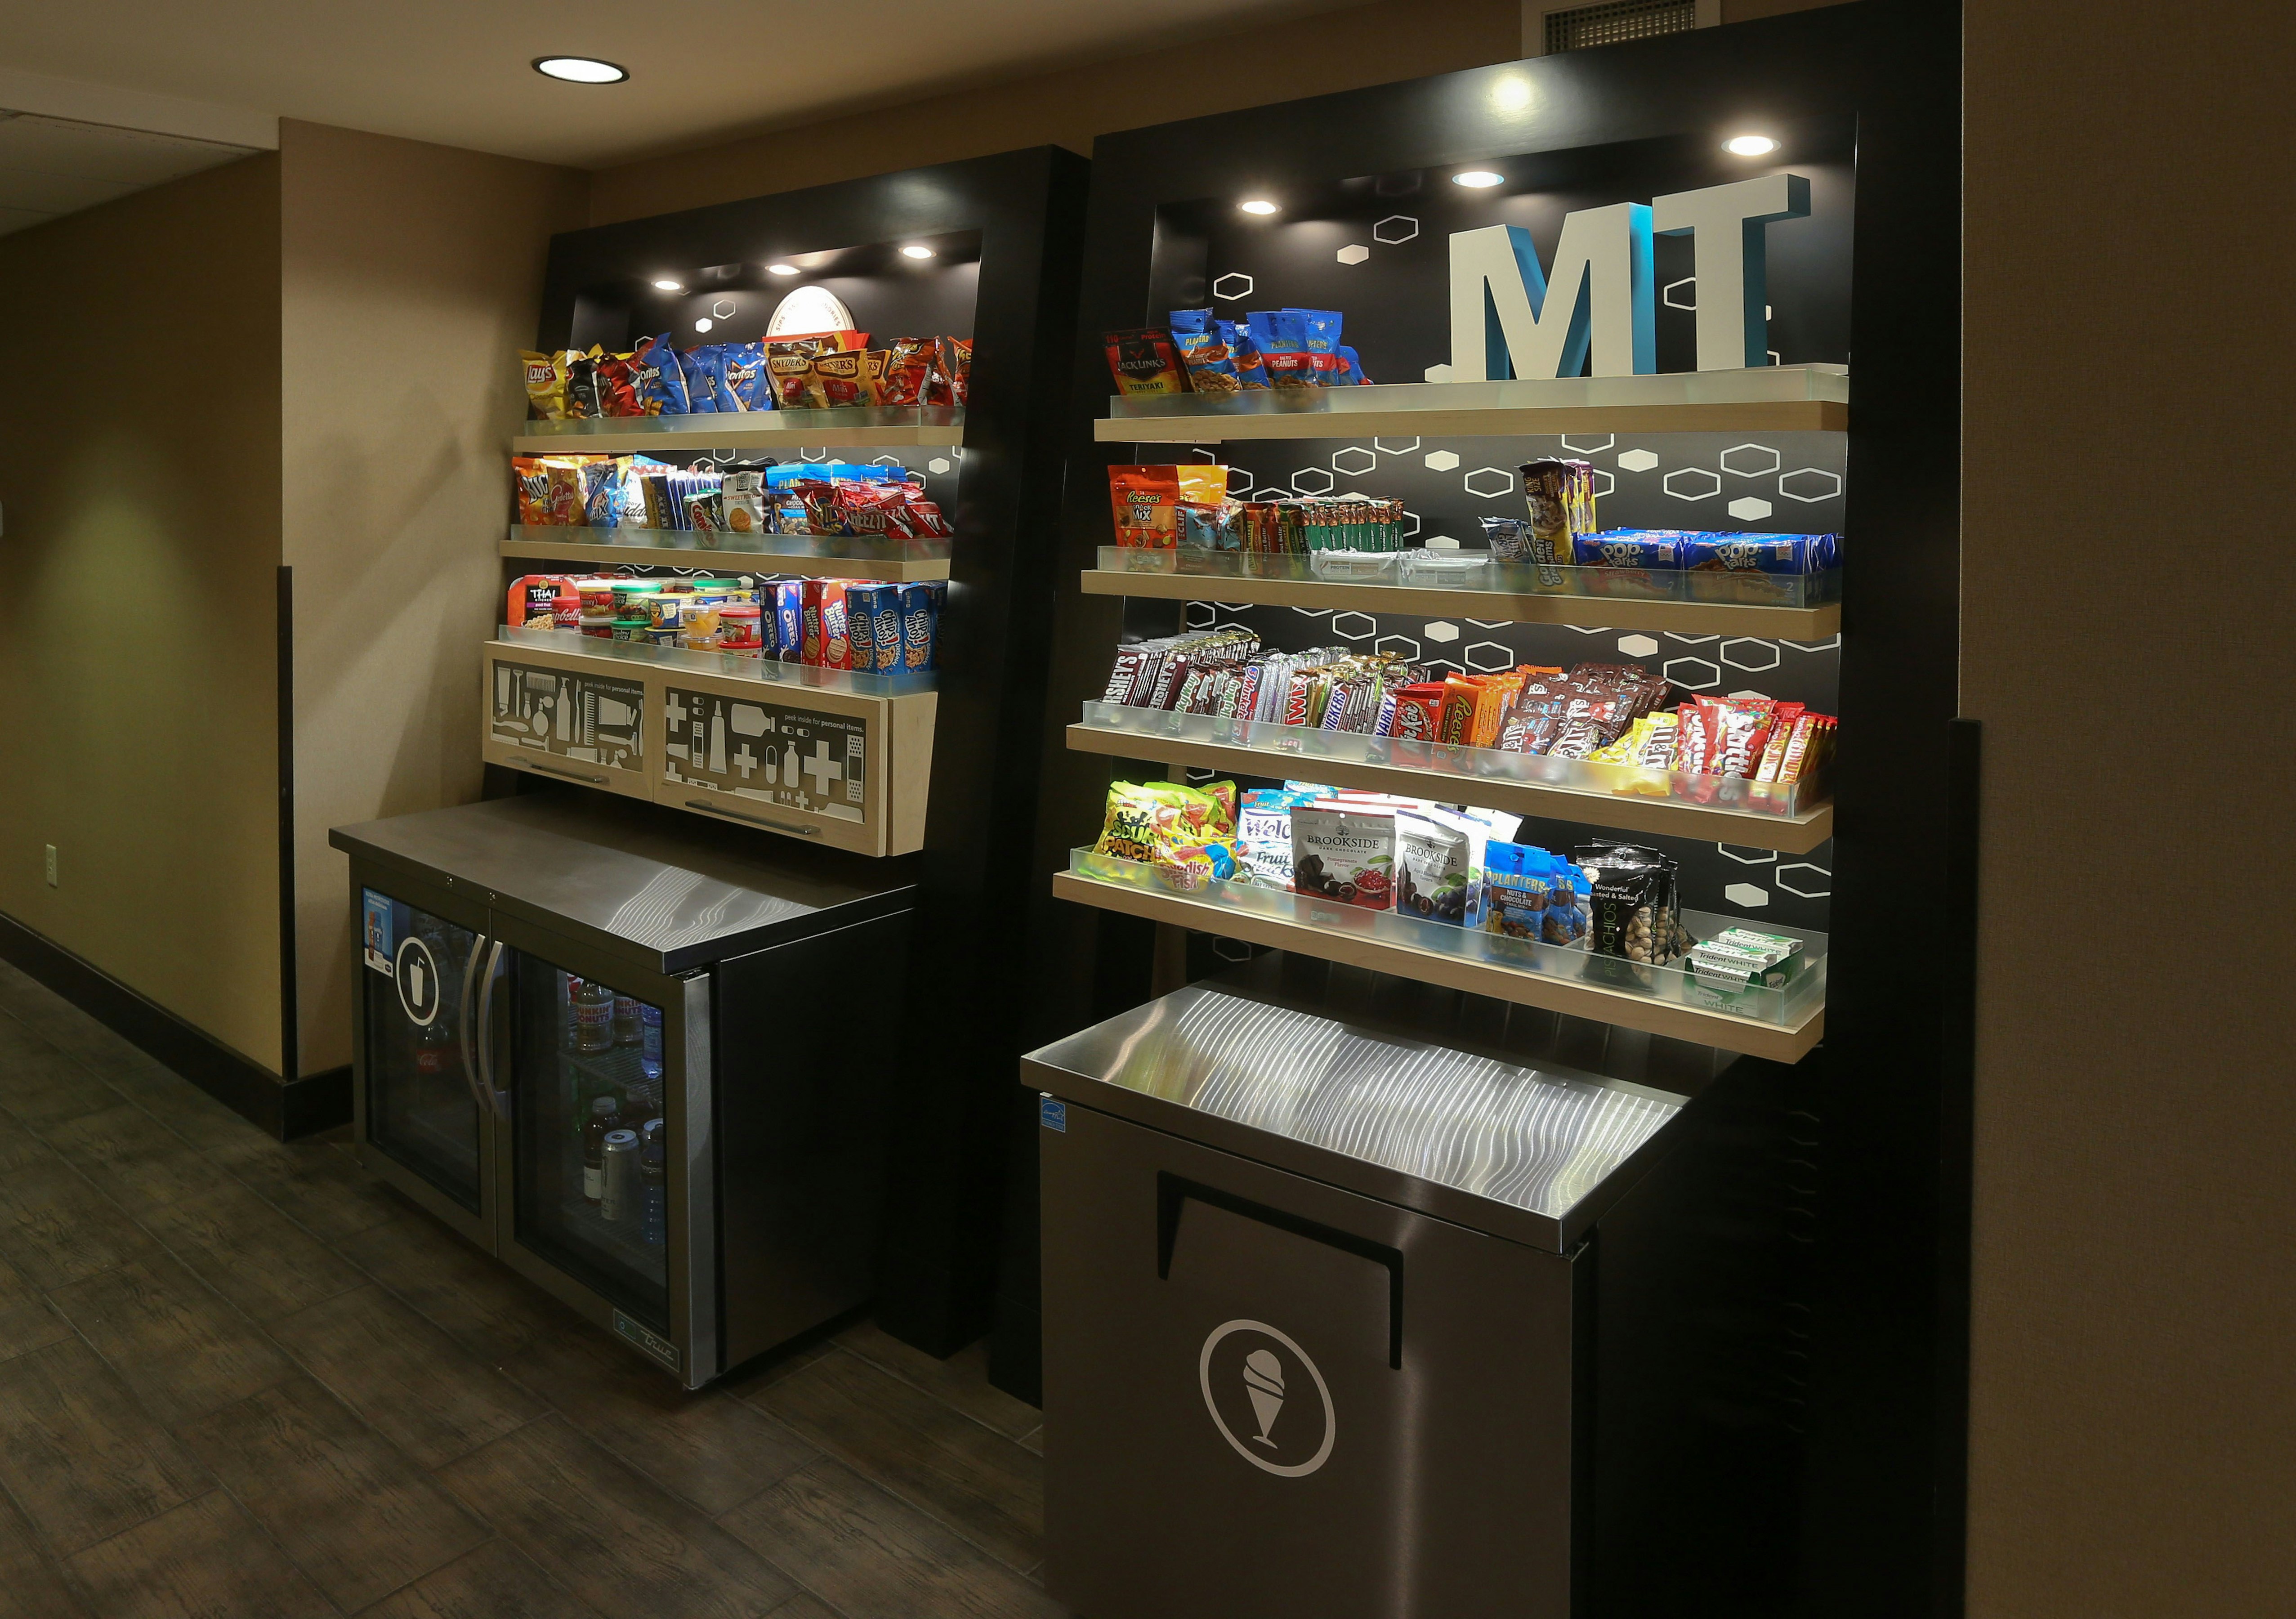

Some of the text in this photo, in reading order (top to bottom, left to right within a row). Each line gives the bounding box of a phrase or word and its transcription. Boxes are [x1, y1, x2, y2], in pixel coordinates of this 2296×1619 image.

[1449, 174, 1811, 381] MT
[1272, 359, 1298, 368] PEANUTS
[1129, 382, 1164, 391] TERIYAKI
[1524, 476, 1534, 493] KING
[1532, 477, 1541, 492] SIZE
[1126, 490, 1161, 503] Reese's
[530, 589, 556, 599] THAI
[803, 609, 815, 638] Butter
[809, 605, 820, 635] Nutter
[824, 606, 840, 639] Butter
[832, 600, 847, 635] Nutter
[855, 613, 869, 641] Chips
[880, 610, 896, 637] Chips
[914, 609, 928, 637] Chips
[764, 610, 775, 648] OREO
[783, 609, 796, 646] OREO
[1102, 655, 1138, 704] RSHEY'S
[1148, 661, 1176, 710] ERSHEY'S
[612, 686, 630, 694] personal
[1323, 689, 1346, 731] NICKERS
[1401, 703, 1423, 733] Kat
[784, 714, 797, 723] peek
[798, 716, 812, 725] inside
[821, 720, 845, 732] personal
[846, 723, 865, 733] items.
[1112, 820, 1158, 846] SOUR
[1245, 816, 1291, 839] Welc
[1103, 836, 1156, 863] PATCH
[1307, 835, 1380, 850] BROOKSIDE
[1406, 843, 1458, 867] BROOKSIDE
[1492, 873, 1546, 892] PLANTERS
[1595, 883, 1628, 893] Wonderful
[1500, 894, 1532, 907] CHOCOLATE
[1506, 889, 1522, 898] NUTS
[1618, 893, 1639, 902] Salted
[1726, 938, 1782, 956] Trident WHITE
[1699, 952, 1759, 969] Trident WHITE
[1694, 967, 1748, 984] Trident WHIT
[1697, 991, 1719, 1000] Trident
[1704, 999, 1744, 1013] WHITE
[580, 1013, 610, 1023] ONUTS
